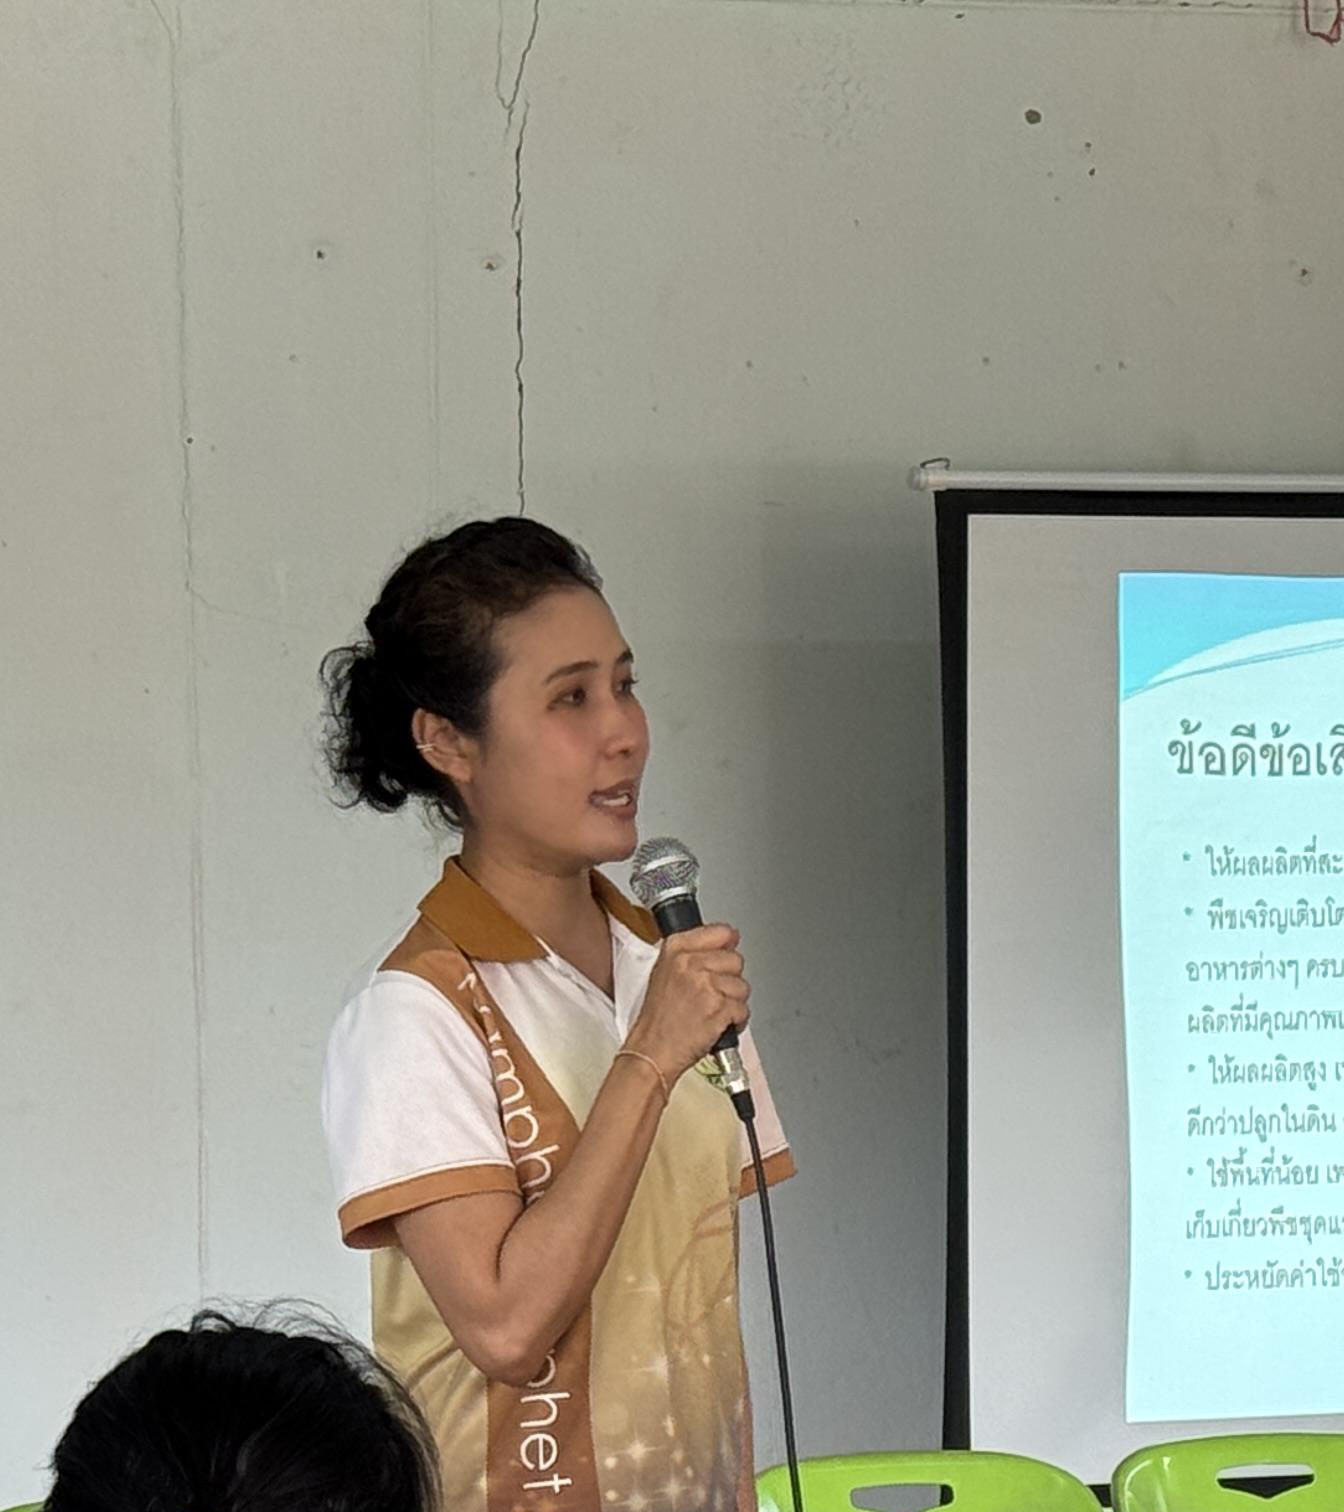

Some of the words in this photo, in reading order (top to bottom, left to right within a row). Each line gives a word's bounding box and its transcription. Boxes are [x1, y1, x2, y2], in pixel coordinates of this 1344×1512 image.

[1185, 950, 1300, 990] อาหารต่างๆ
[1207, 1052, 1327, 1092] ให้ผลผลิตสูง
[1186, 1102, 1337, 1144] ดีกว่าปลูกในดิน
[1206, 1145, 1319, 1188] ใช้พื้นที่น้อย
